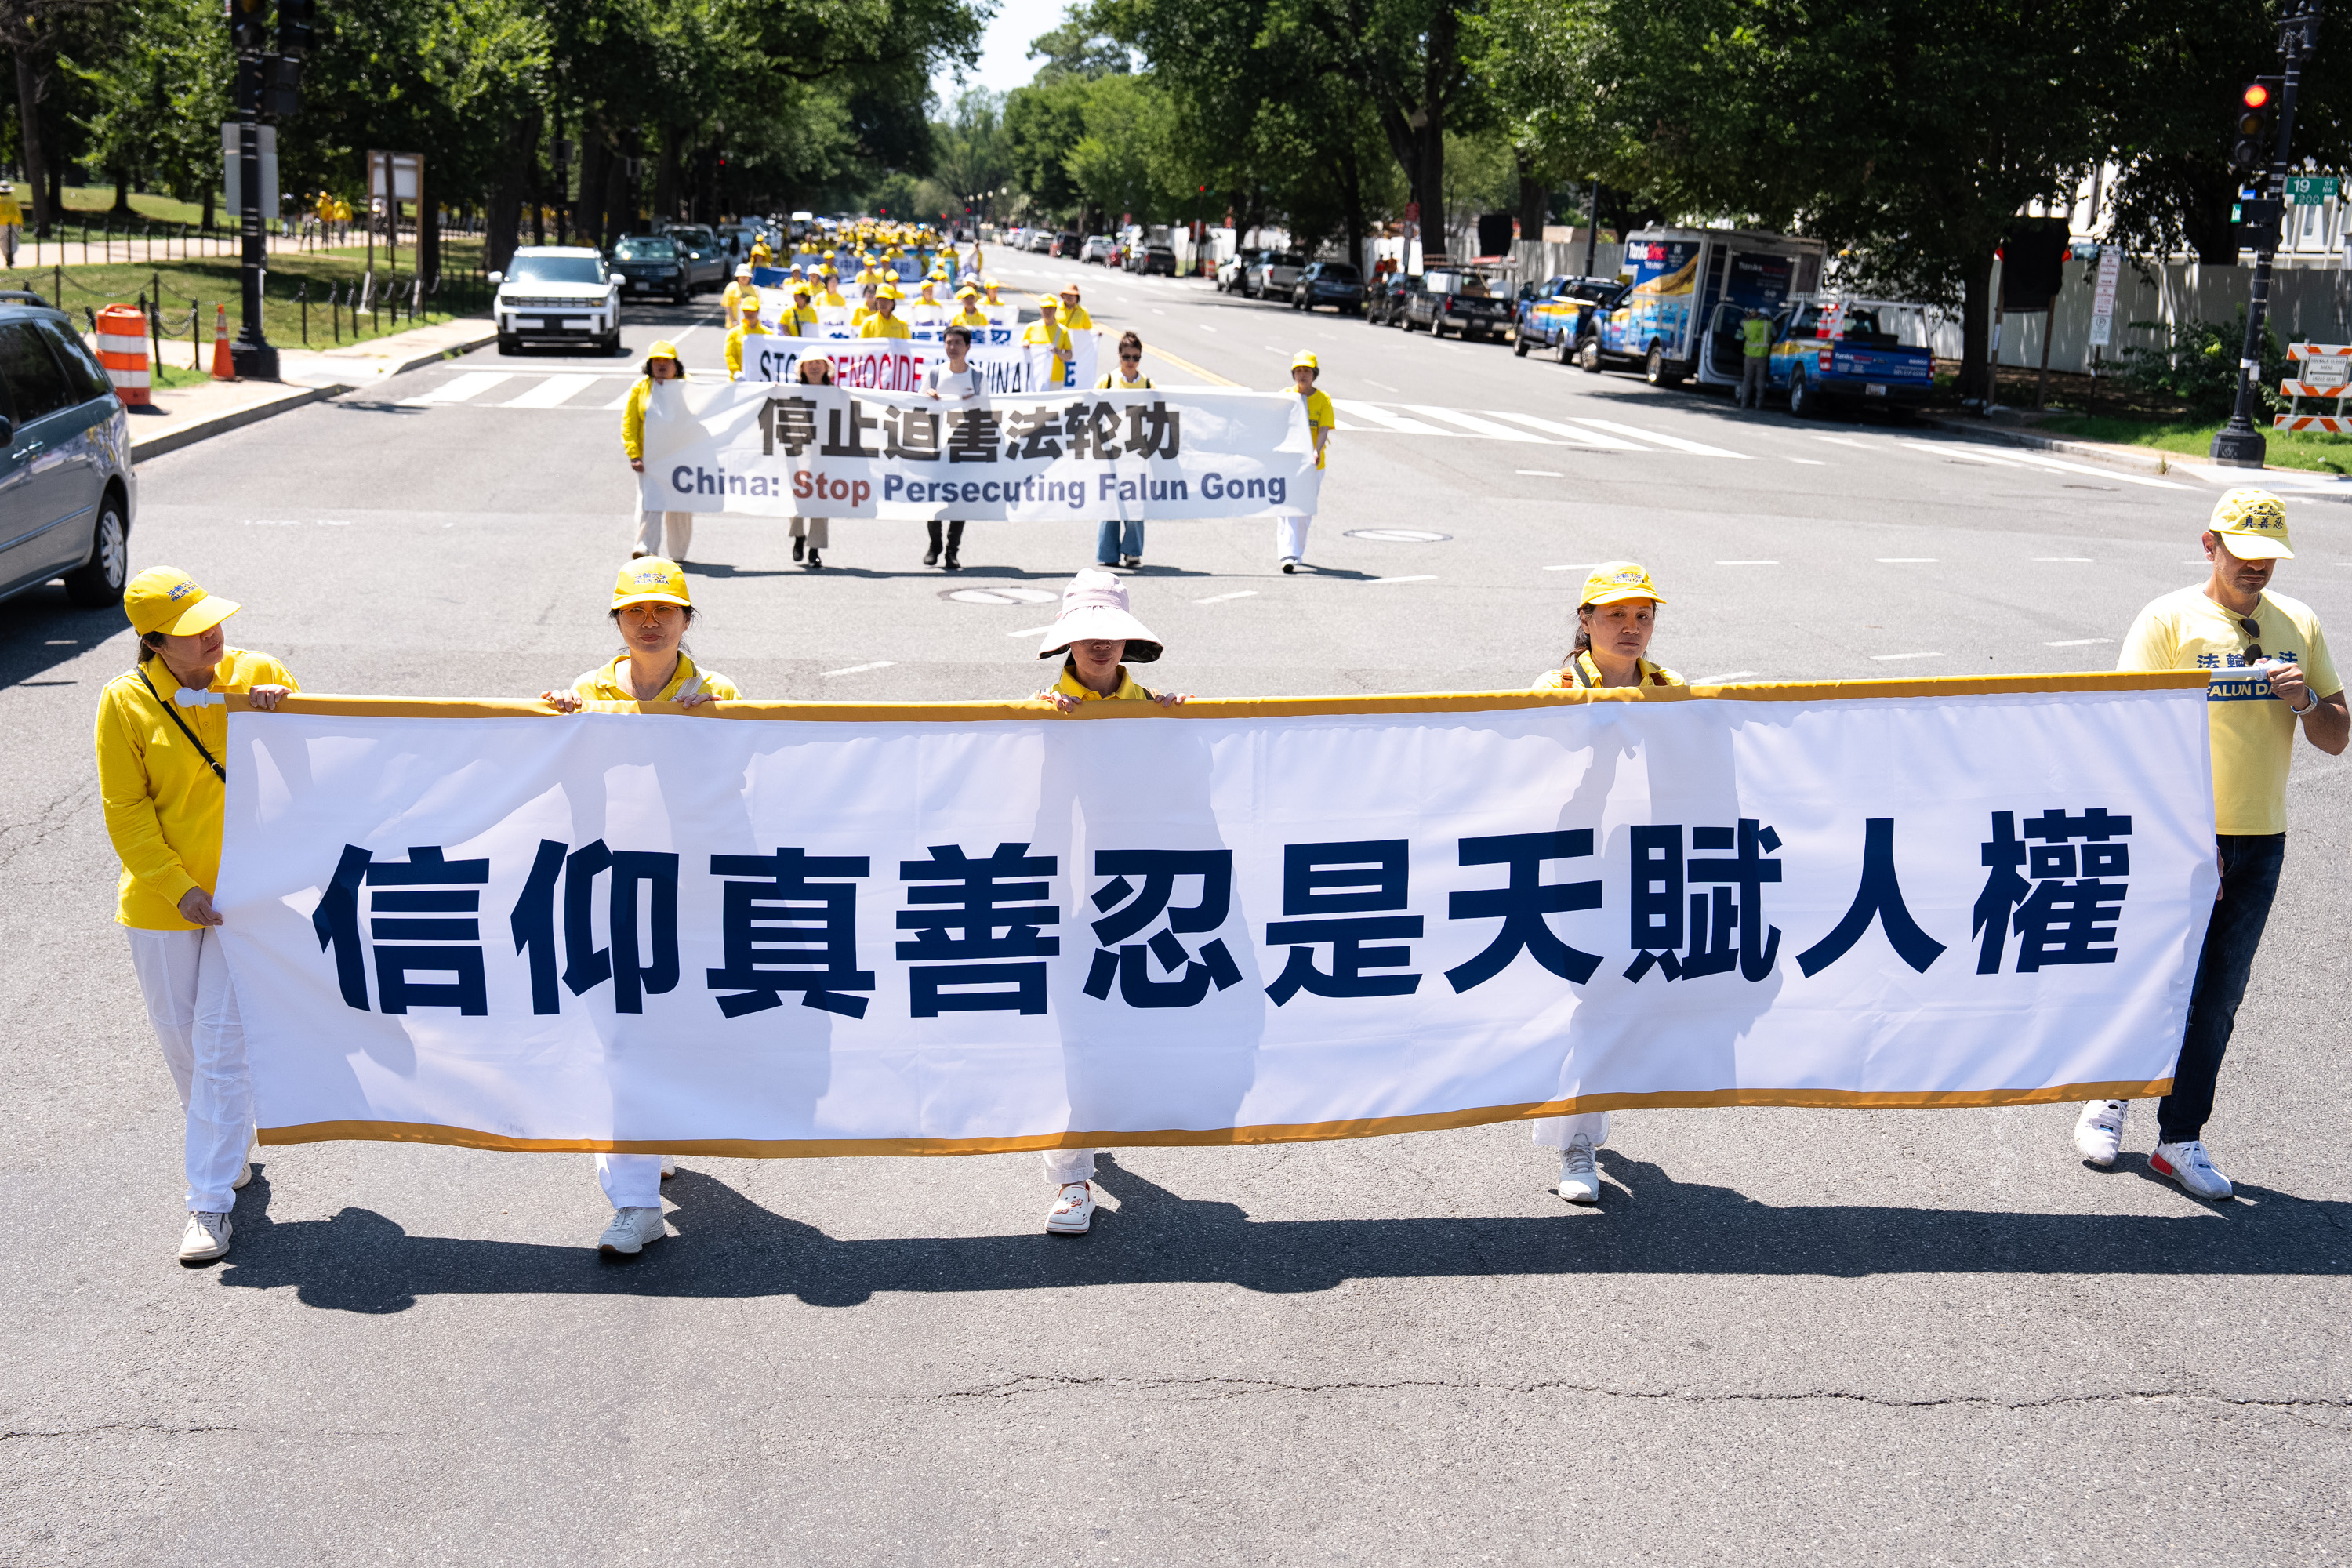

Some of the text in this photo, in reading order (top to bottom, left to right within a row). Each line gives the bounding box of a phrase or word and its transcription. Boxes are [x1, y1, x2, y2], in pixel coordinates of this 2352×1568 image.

[2293, 179, 2310, 193] 19
[2298, 194, 2320, 204] 200
[760, 350, 798, 383] STO
[758, 396, 1181, 463] 停止迫害法轮功
[671, 465, 1286, 508] China: Stop Persecuting Falun Gong
[2241, 514, 2284, 529] 真善忍
[2196, 651, 2299, 669] 法輪法
[312, 807, 2135, 1020] 信仰真善忍是天賦人權
